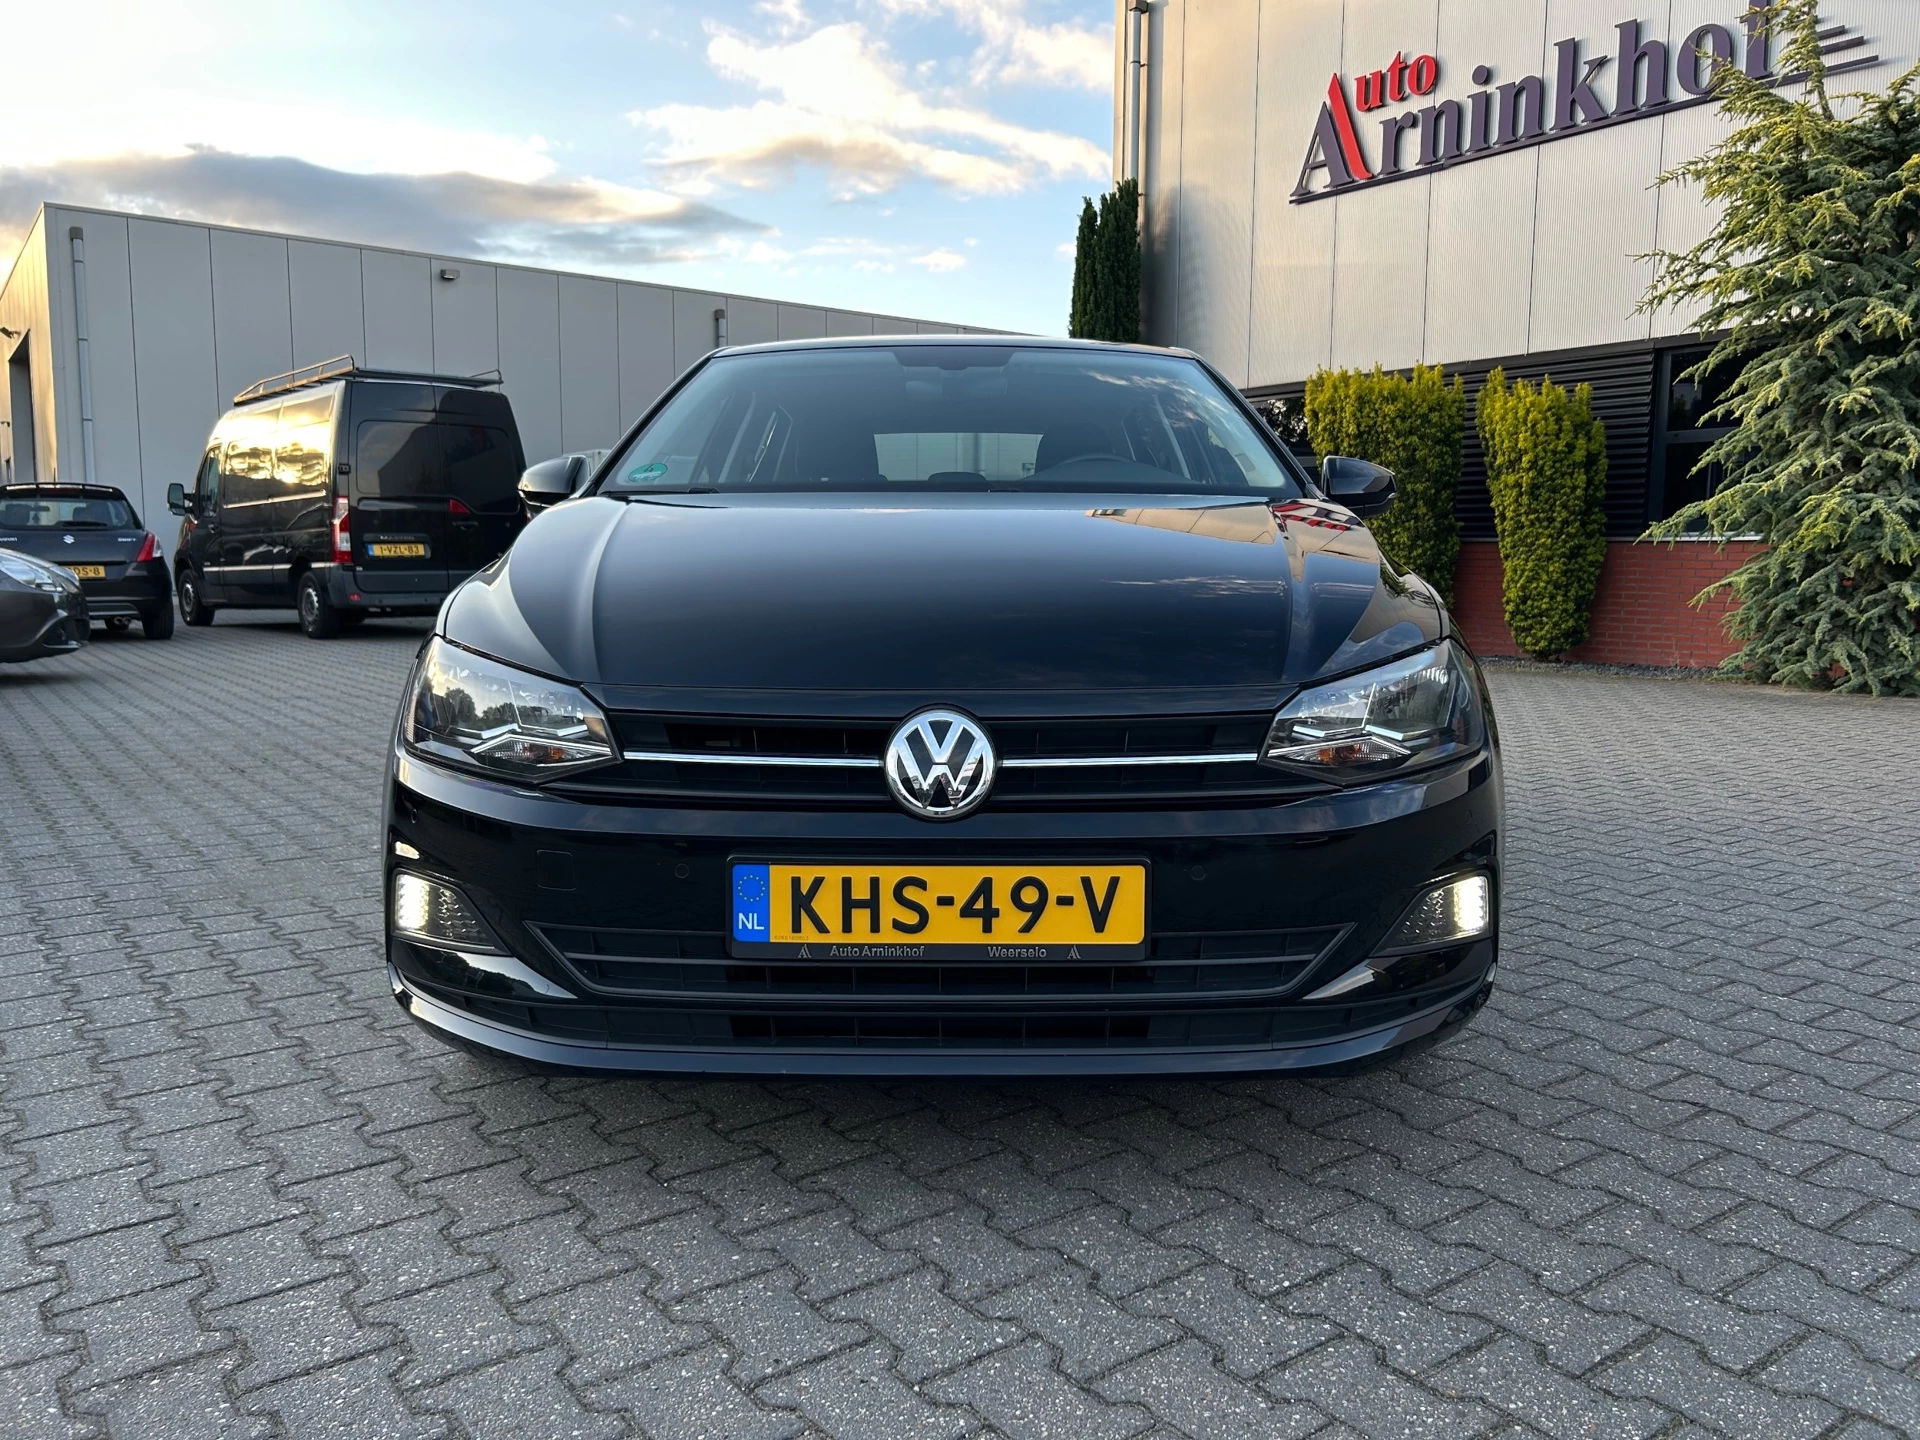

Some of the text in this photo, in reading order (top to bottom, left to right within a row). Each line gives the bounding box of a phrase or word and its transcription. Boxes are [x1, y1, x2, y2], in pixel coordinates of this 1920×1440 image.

[790, 876, 1121, 934] KHS-49-V
[738, 912, 765, 930] NL
[830, 946, 859, 957] Auto
[862, 945, 925, 957] Arninkhof
[988, 946, 1047, 958] Weerselo
